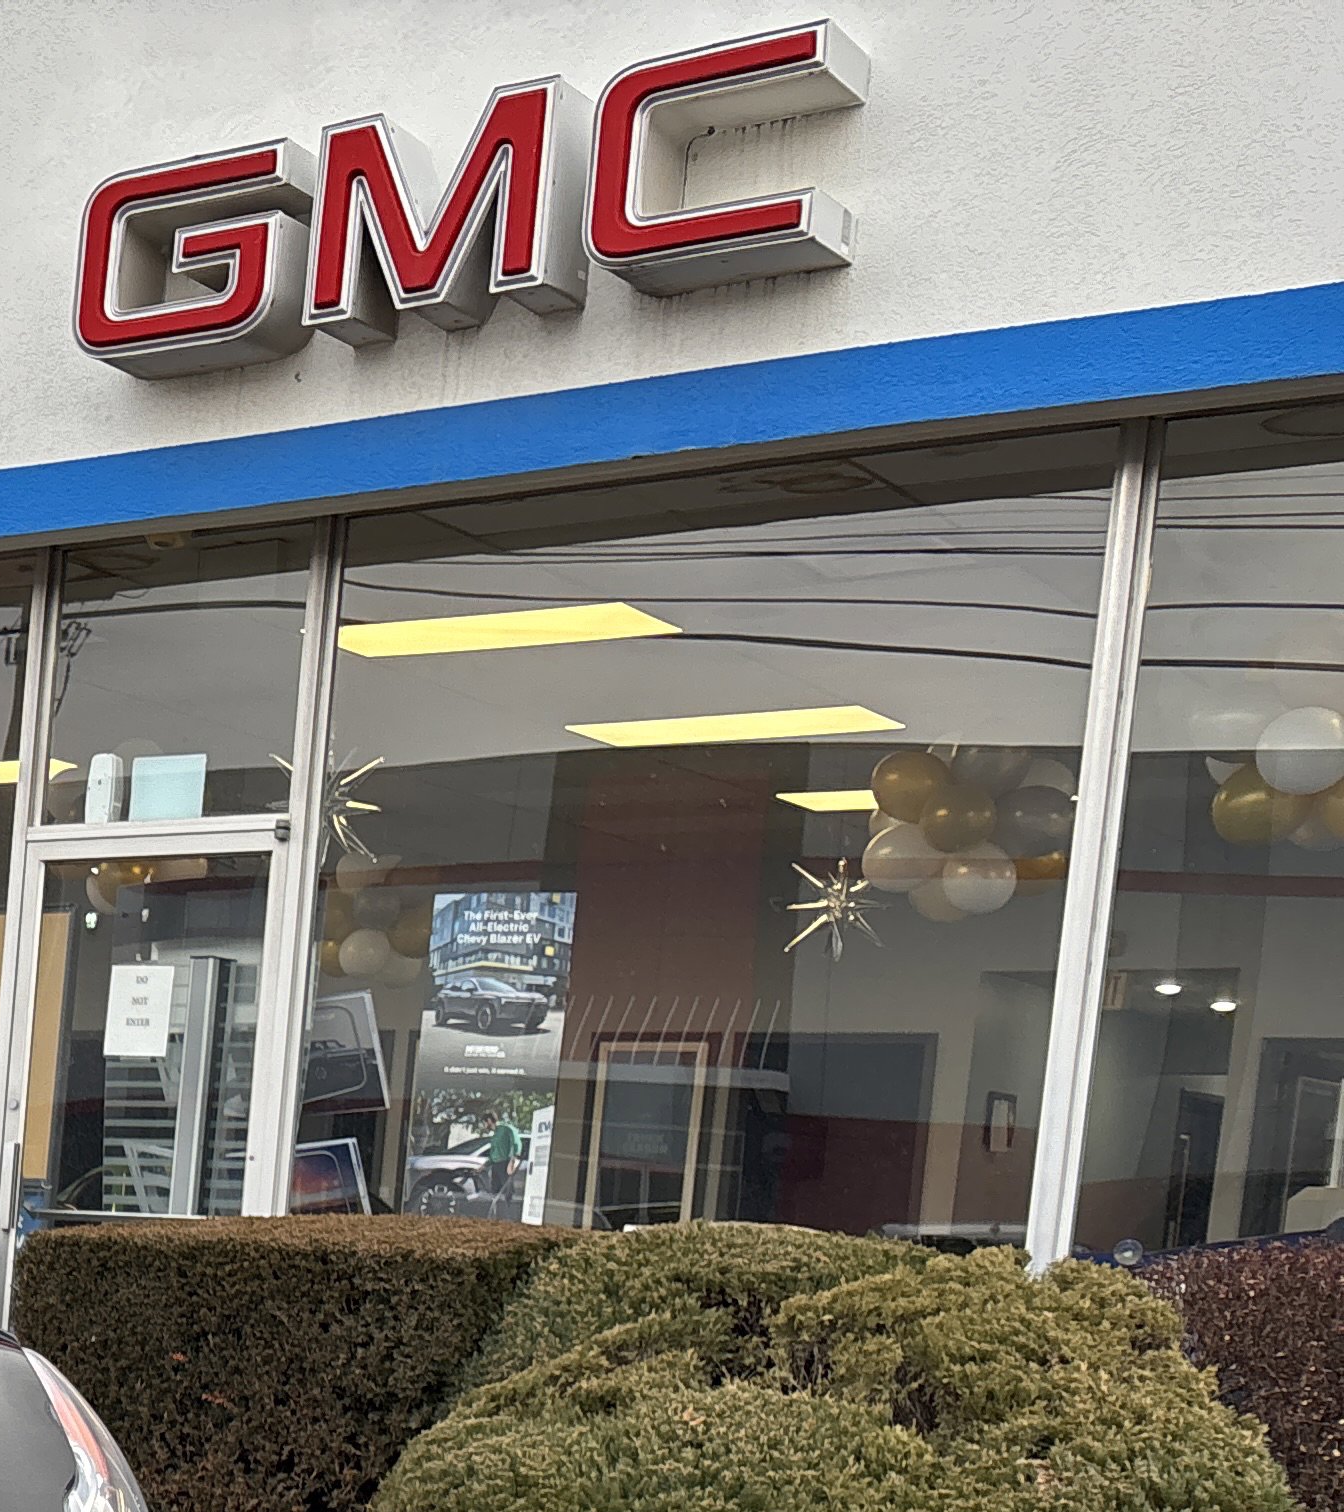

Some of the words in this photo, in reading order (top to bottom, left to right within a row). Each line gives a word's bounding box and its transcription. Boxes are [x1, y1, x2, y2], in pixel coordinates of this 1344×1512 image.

[74, 18, 844, 366] GMC
[464, 911, 481, 921] The
[484, 911, 539, 921] First-Ever
[469, 922, 529, 932] All-Electric
[456, 934, 488, 945] Chevy
[489, 934, 524, 944] Blazer
[525, 934, 541, 944] EV
[136, 976, 148, 984] DO
[132, 997, 148, 1005] NOT
[126, 1018, 150, 1026] ENTER
